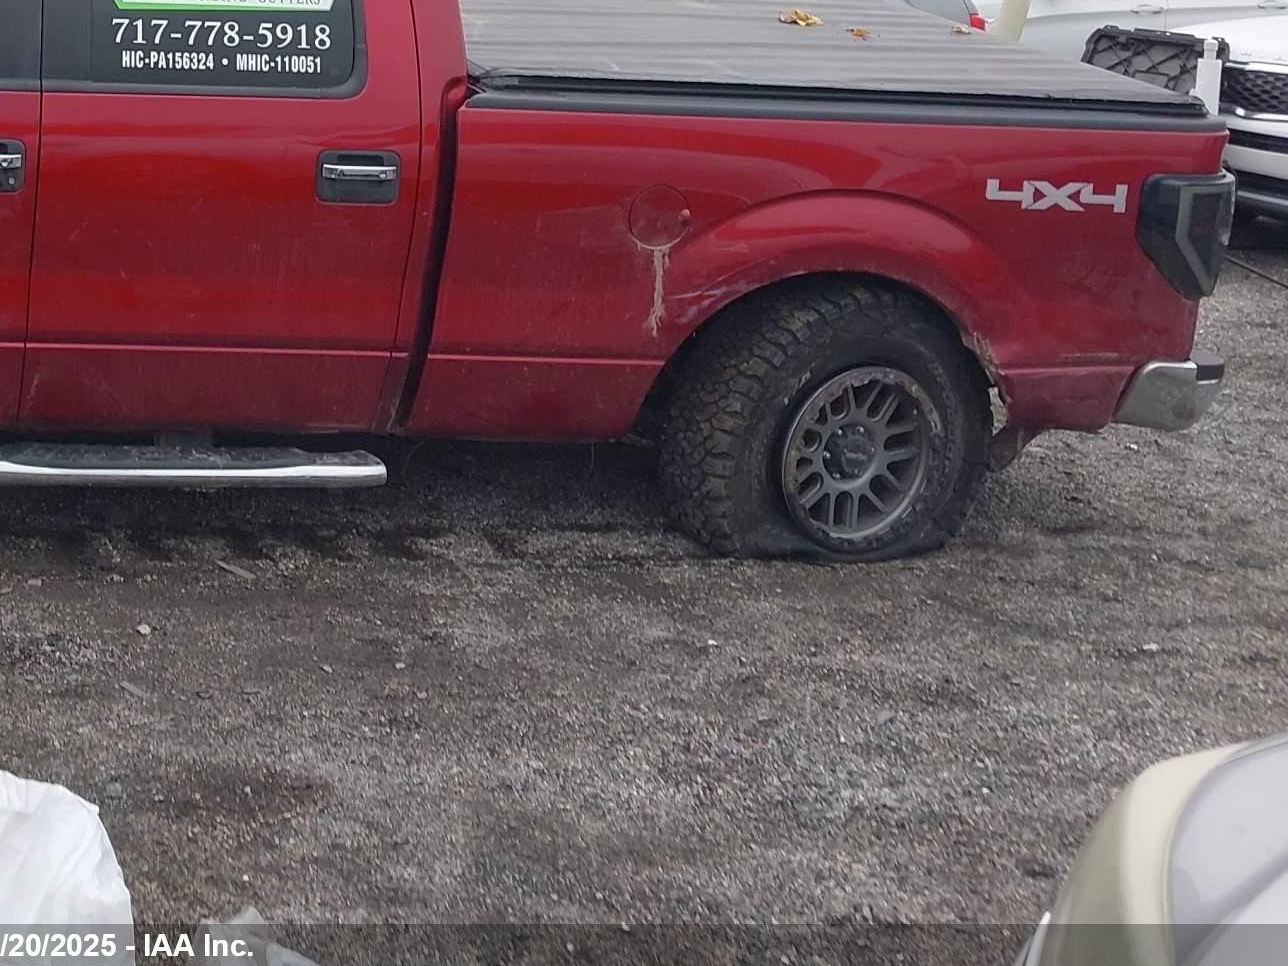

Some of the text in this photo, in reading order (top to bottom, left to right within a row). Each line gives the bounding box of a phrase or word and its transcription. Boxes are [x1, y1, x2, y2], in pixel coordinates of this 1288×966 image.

[112, 18, 332, 50] 717-778-5918
[122, 50, 322, 74] HIC-PA156324 MHIC-110051
